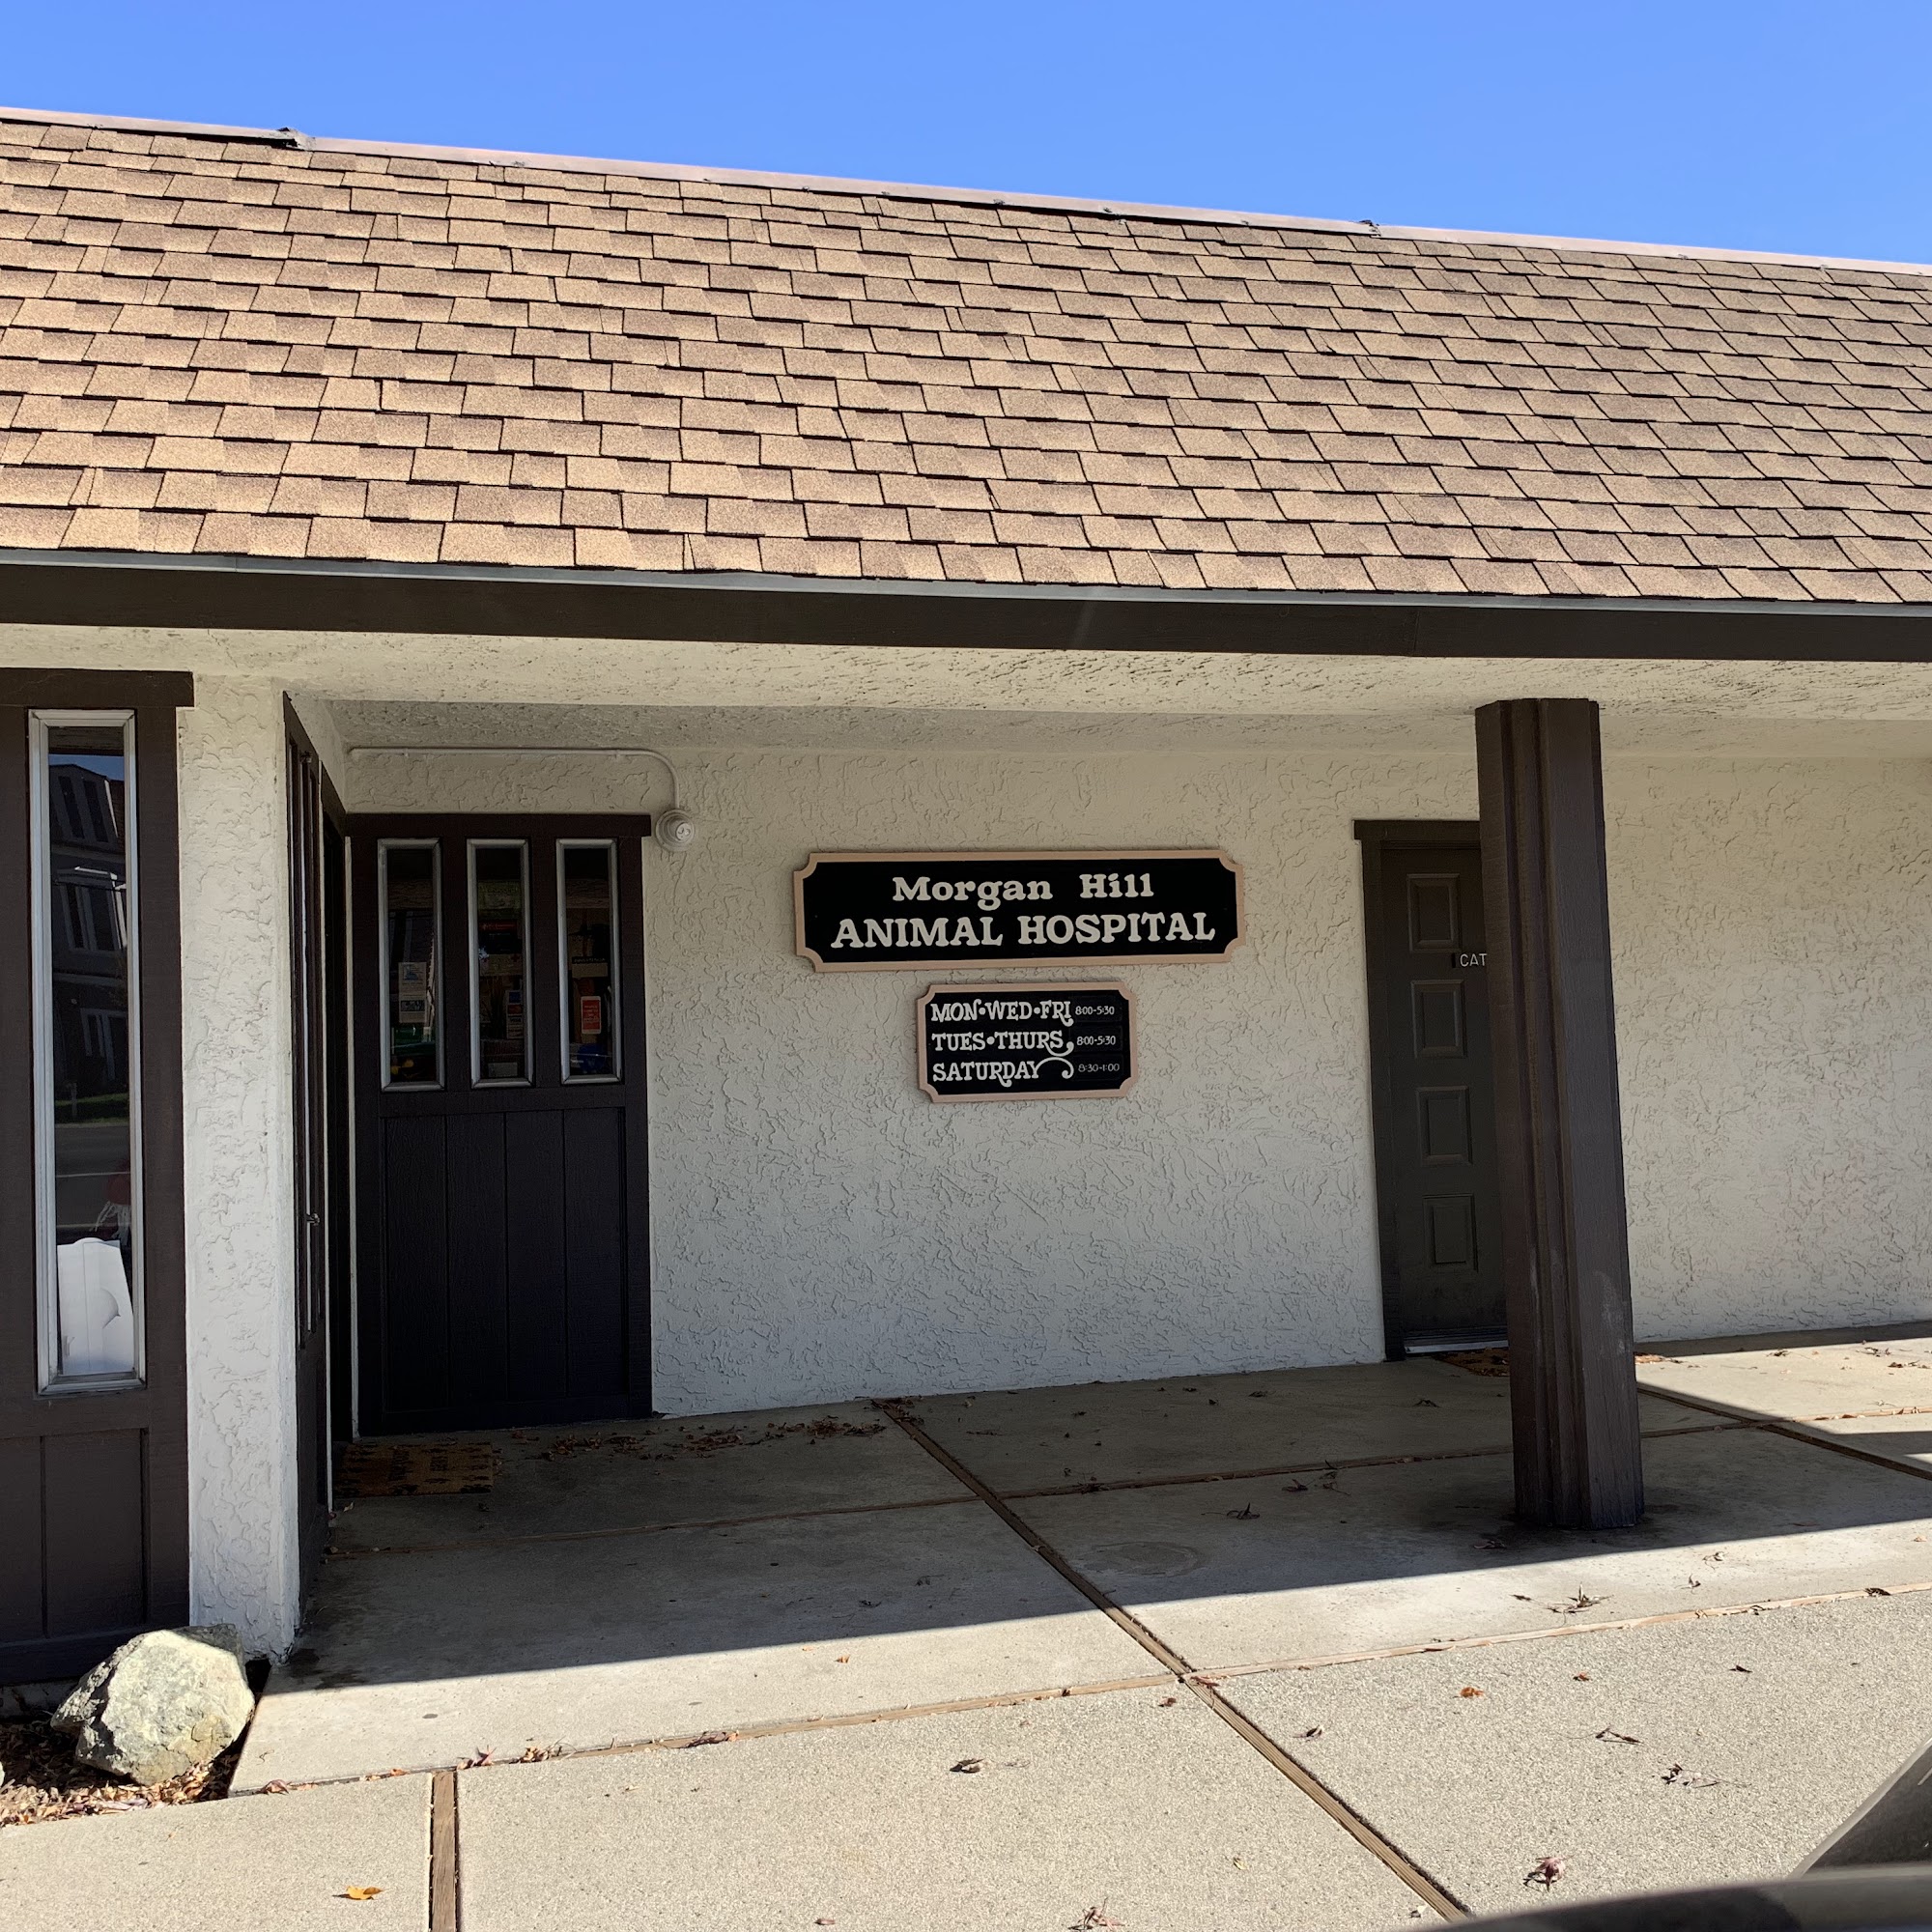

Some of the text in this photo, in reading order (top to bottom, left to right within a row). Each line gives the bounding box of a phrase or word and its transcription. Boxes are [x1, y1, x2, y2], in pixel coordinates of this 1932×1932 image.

[892, 872, 1154, 912] Morgan Hill
[830, 911, 1216, 950] ANIMAL HOSPITAL
[1459, 952, 1489, 967] CAT
[932, 1057, 1075, 1088] SATURDAY
